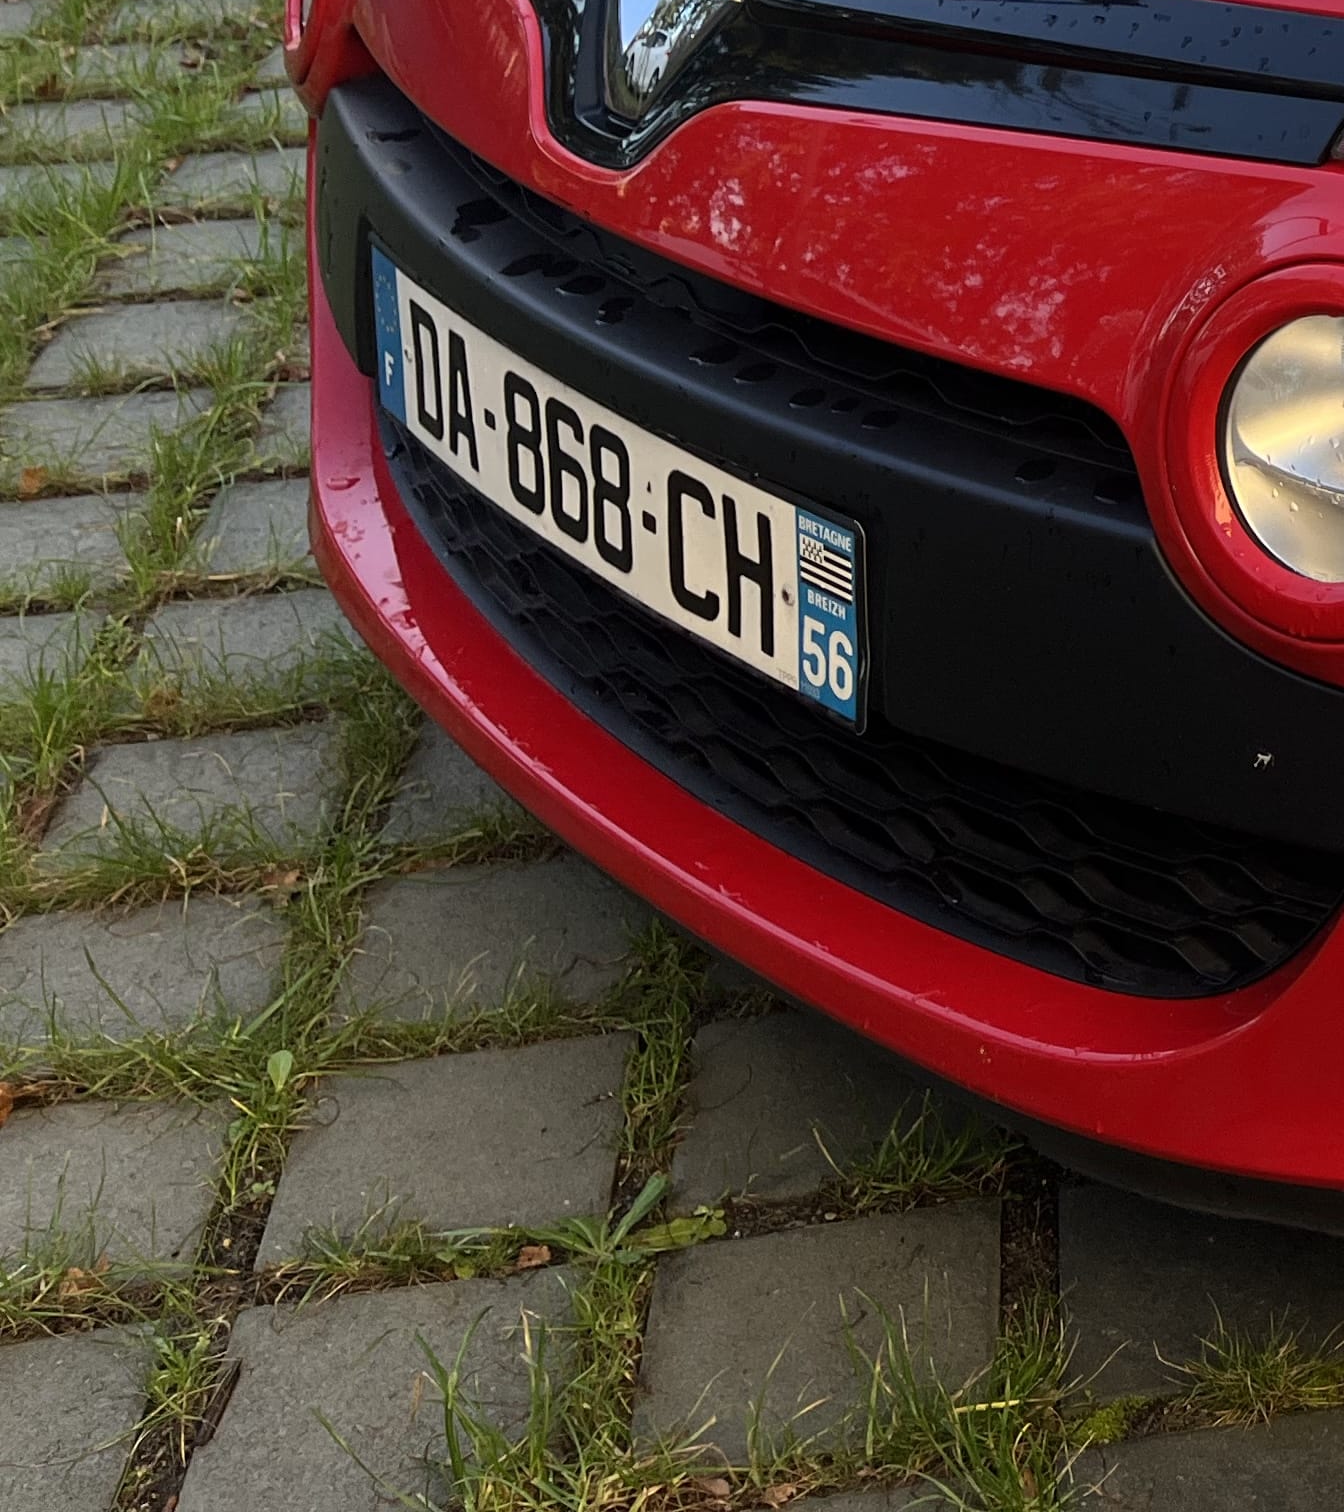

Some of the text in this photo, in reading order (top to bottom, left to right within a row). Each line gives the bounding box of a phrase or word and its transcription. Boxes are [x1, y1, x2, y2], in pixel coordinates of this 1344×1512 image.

[384, 350, 395, 386] F
[798, 514, 852, 553] BRETAGNE
[807, 589, 846, 620] BREIZH
[801, 614, 854, 701] 56
